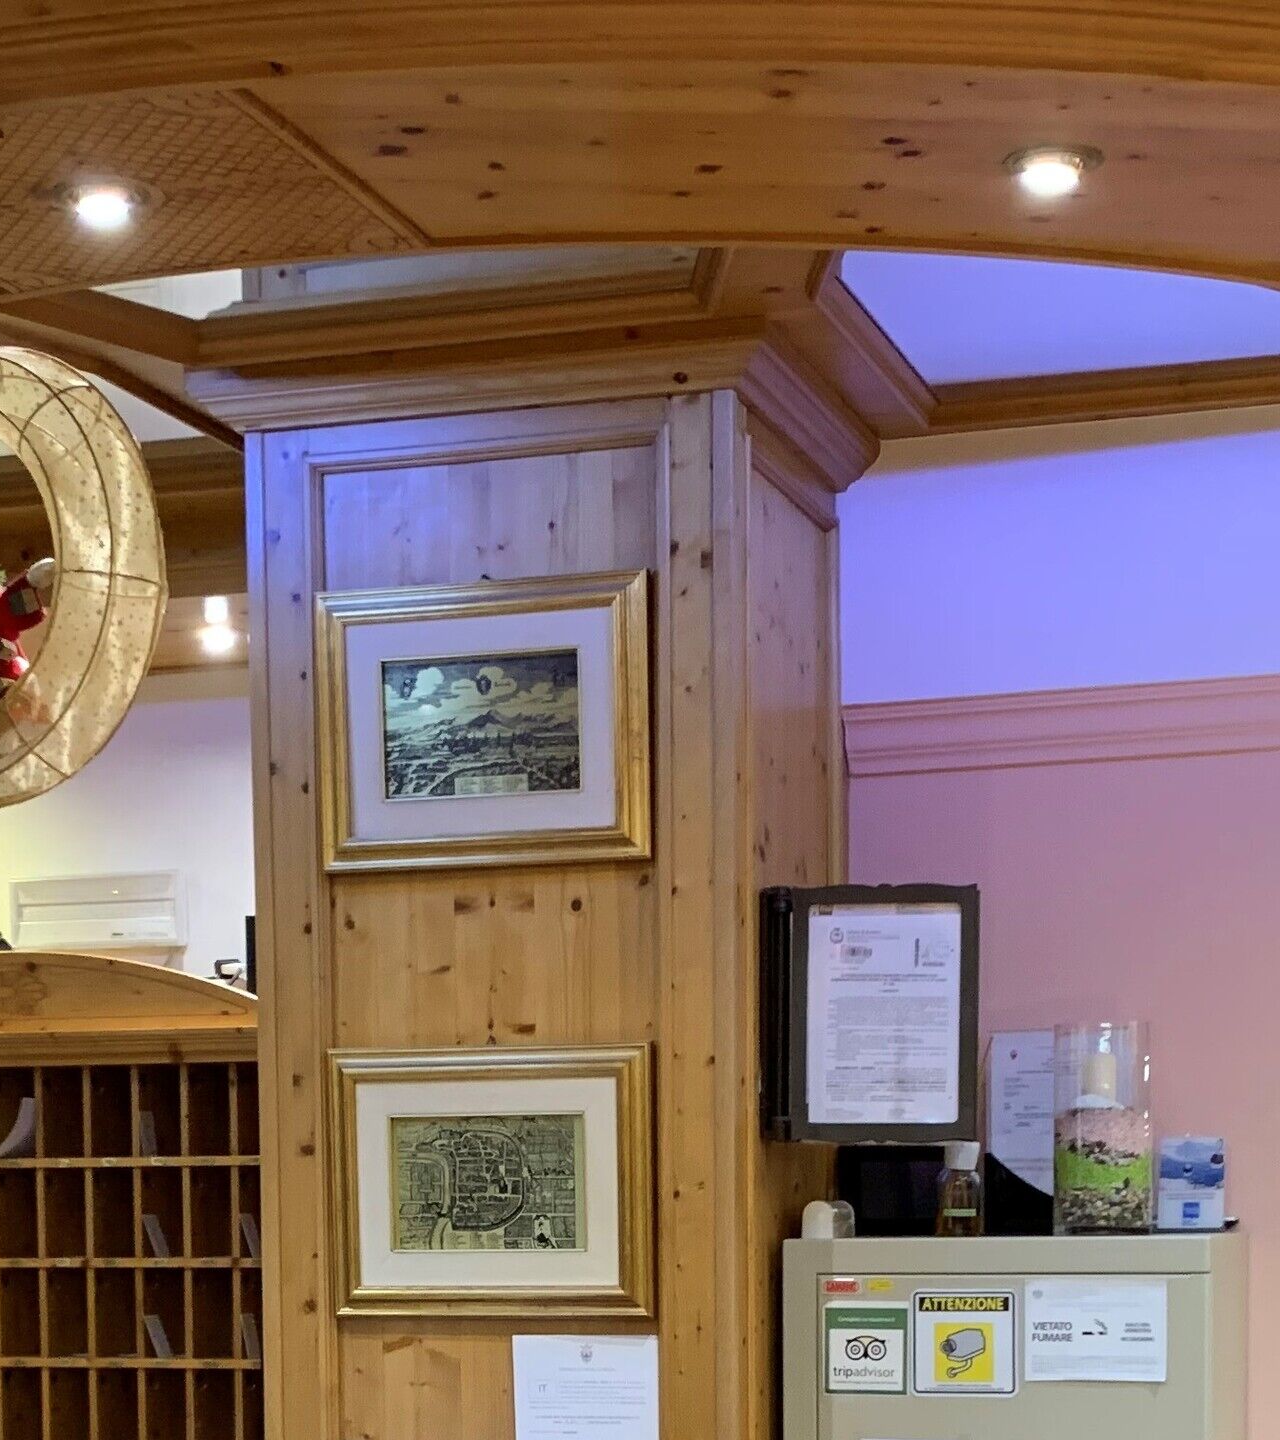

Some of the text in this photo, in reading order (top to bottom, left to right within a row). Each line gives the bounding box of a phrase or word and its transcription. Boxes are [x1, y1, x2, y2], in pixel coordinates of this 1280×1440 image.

[922, 1298, 1004, 1311] ATTENZIONE
[1032, 1321, 1073, 1331] VIETATO
[1032, 1333, 1073, 1342] FUMARE
[833, 1366, 895, 1379] tripadvisor
